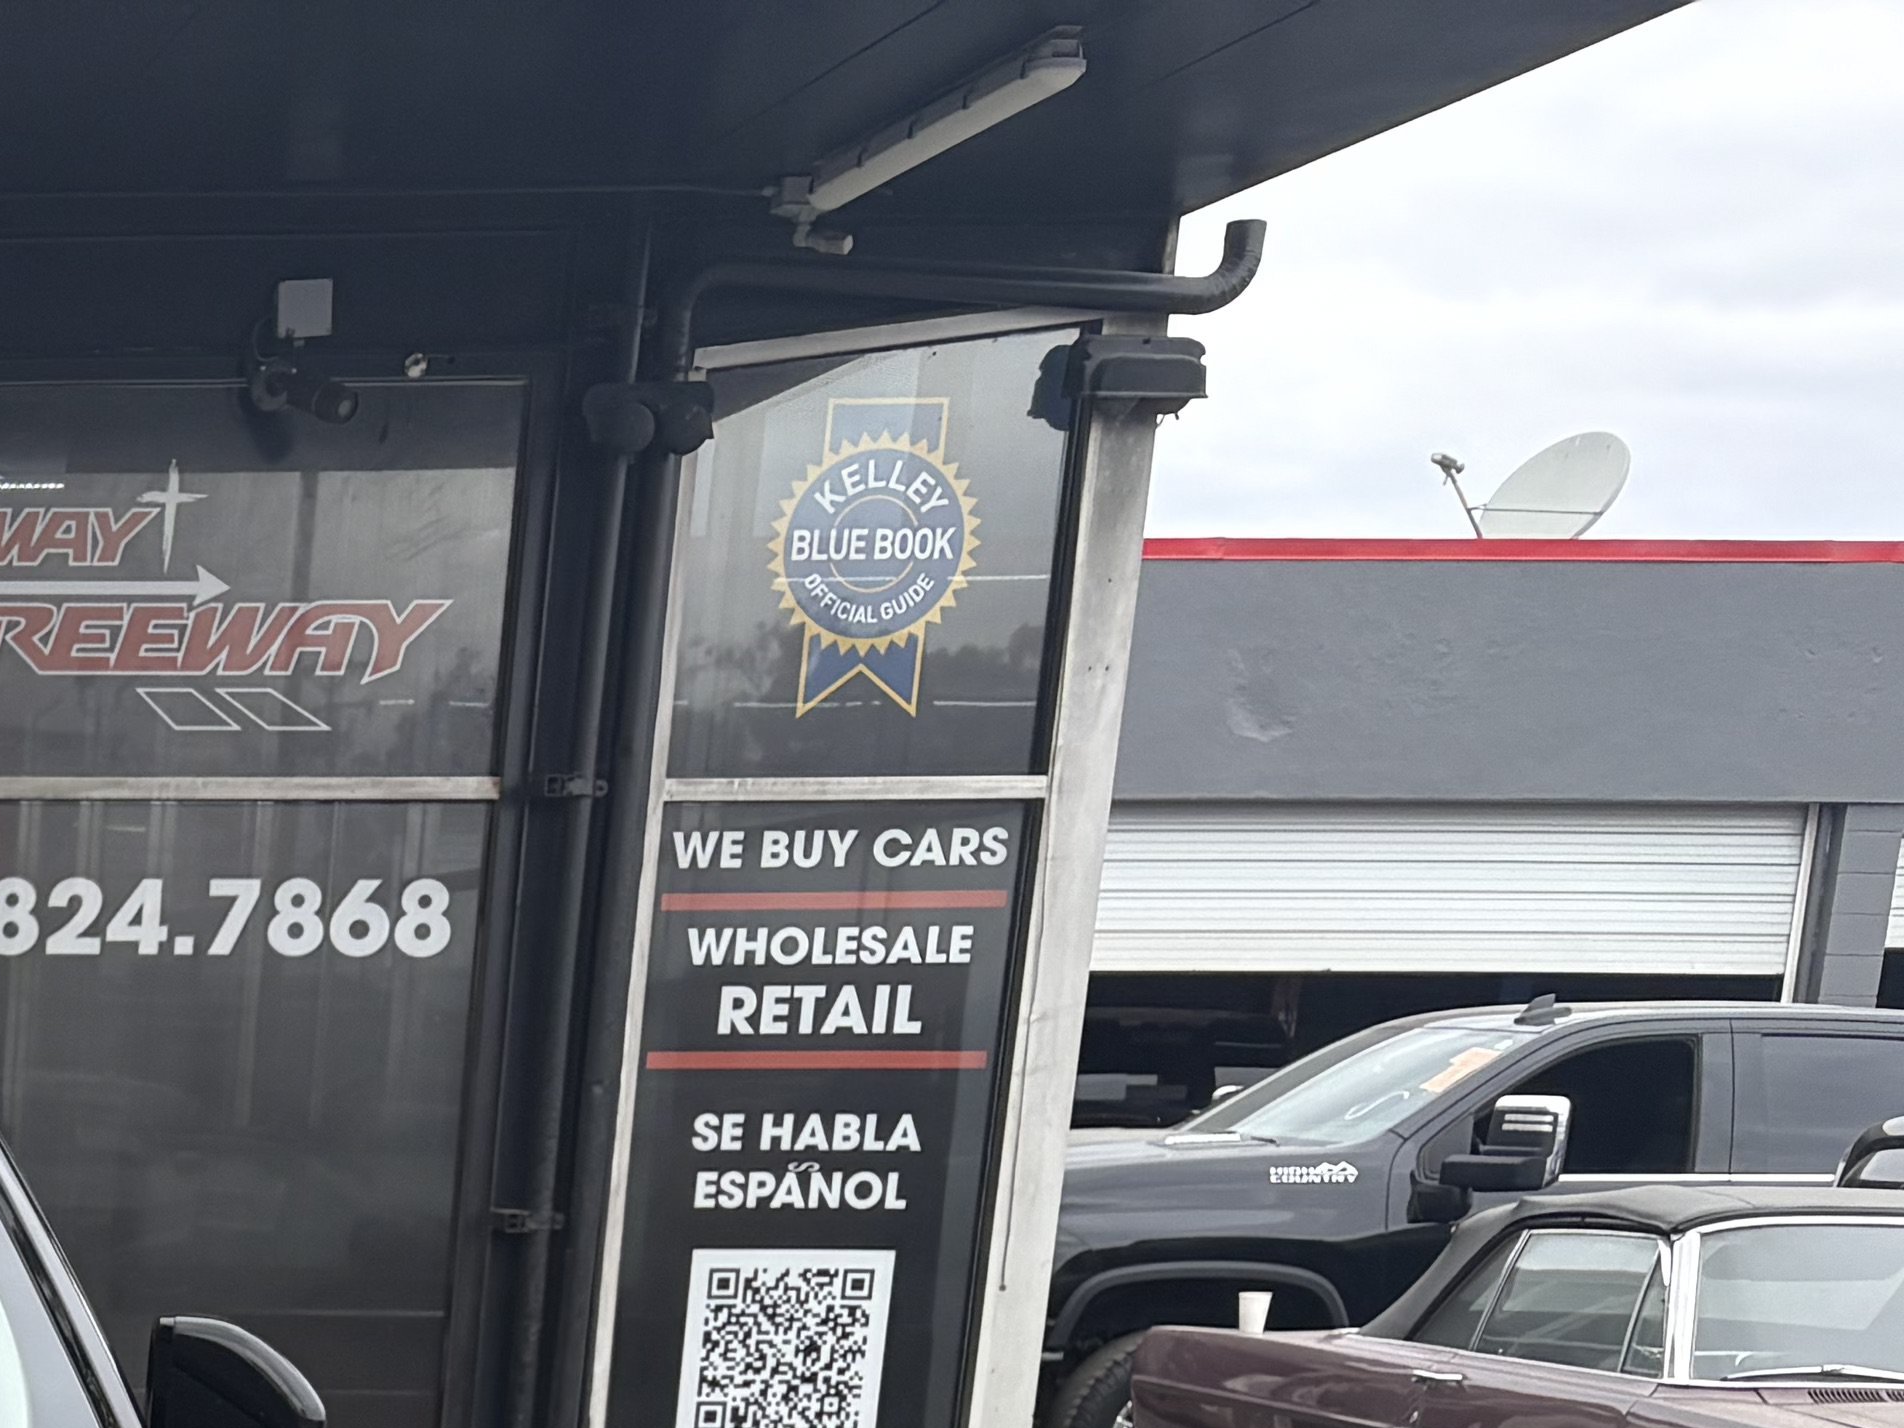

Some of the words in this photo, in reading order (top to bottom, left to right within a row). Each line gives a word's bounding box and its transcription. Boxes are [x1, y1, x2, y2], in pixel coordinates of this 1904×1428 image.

[813, 459, 949, 514] KELLEY
[790, 528, 868, 562] BLUE
[873, 526, 955, 561] BOOK
[803, 572, 878, 625] OFFICIAL
[879, 571, 936, 621] GUIDE
[672, 831, 743, 870] WE
[759, 829, 859, 869] BUY
[872, 826, 1009, 867] CARS
[687, 925, 975, 967] WHOLESALE
[716, 984, 923, 1037] RETAIL
[691, 1113, 744, 1153] SE
[759, 1112, 922, 1153] HABLA
